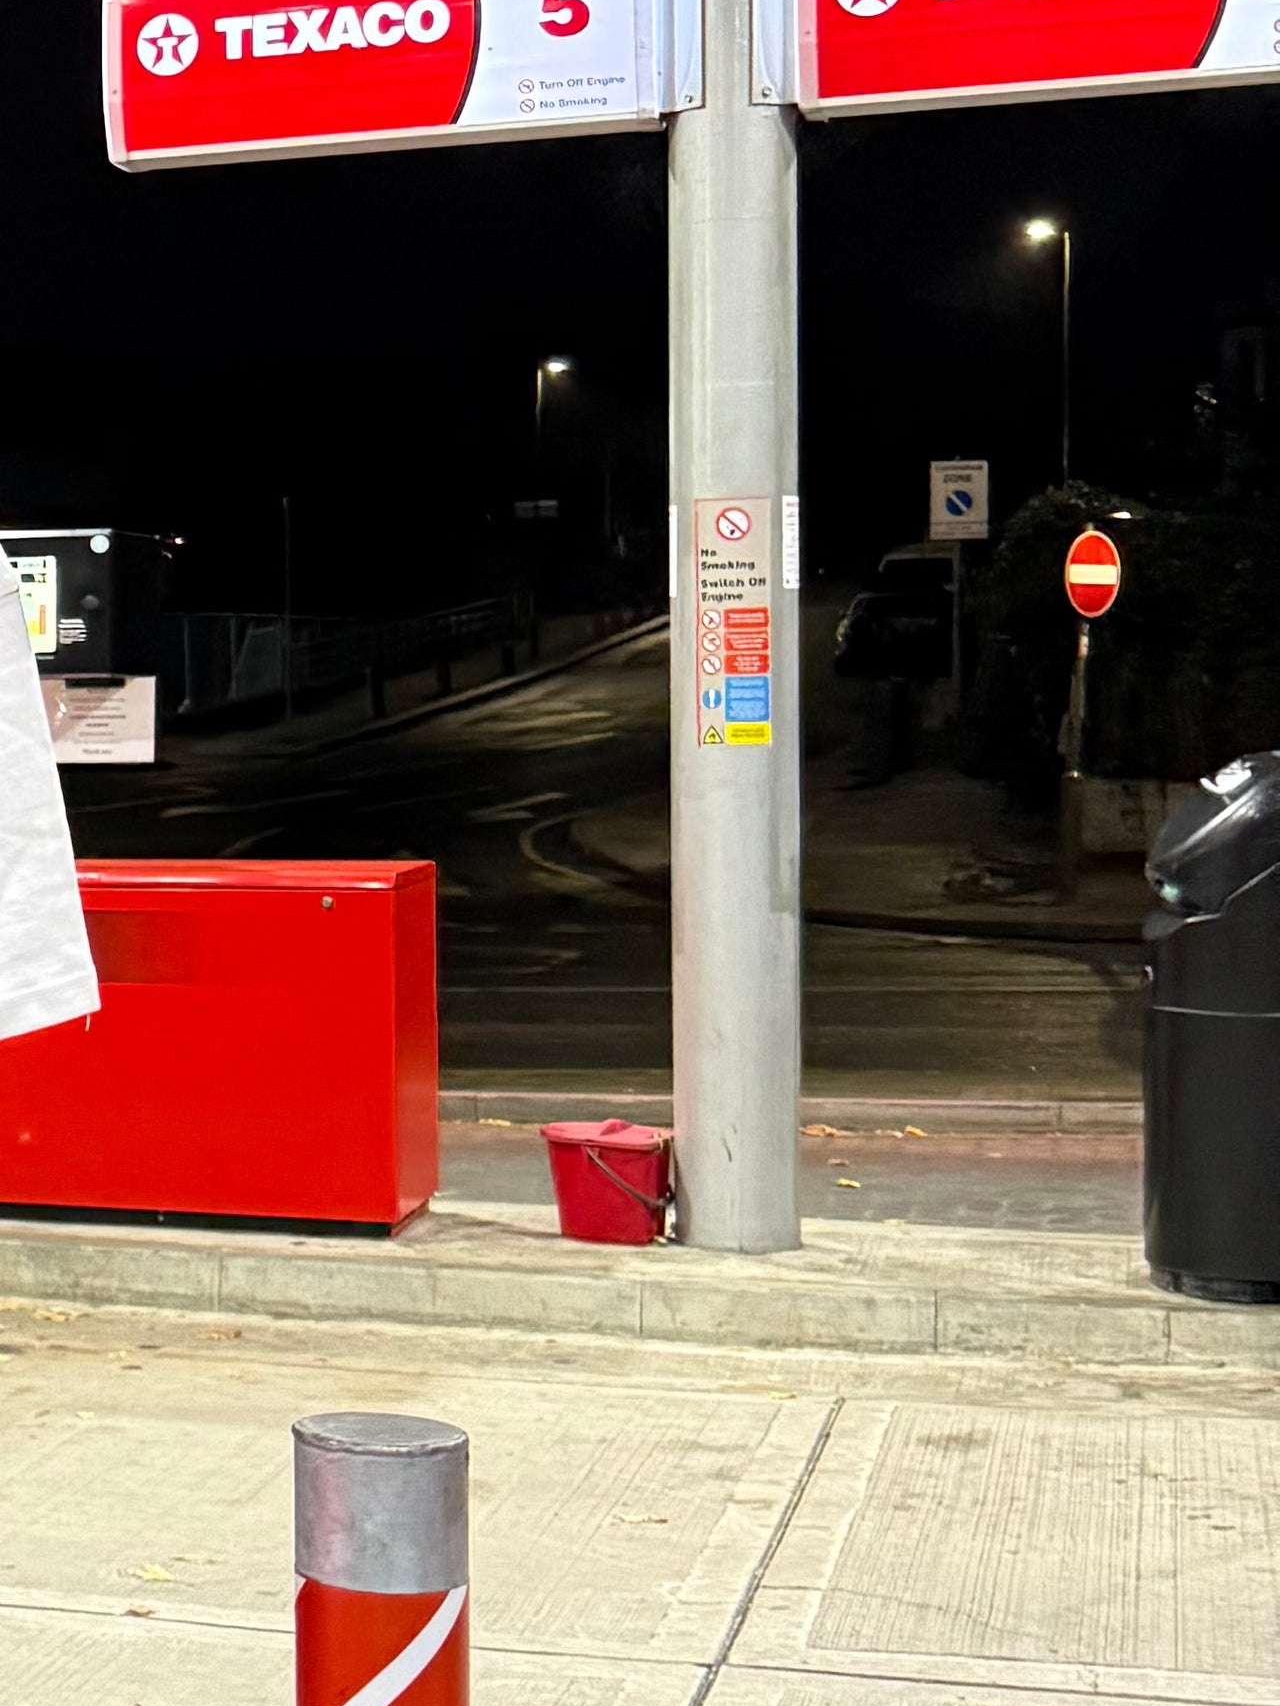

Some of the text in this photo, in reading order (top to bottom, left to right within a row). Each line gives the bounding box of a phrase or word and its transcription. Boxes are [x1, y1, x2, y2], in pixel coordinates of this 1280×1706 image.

[539, 76, 626, 90] Turn Off Engine
[540, 97, 608, 109] No Smoking
[701, 549, 717, 557] No
[701, 561, 755, 571] Smoking
[701, 578, 745, 588] Switch
[701, 592, 743, 603] Engine
